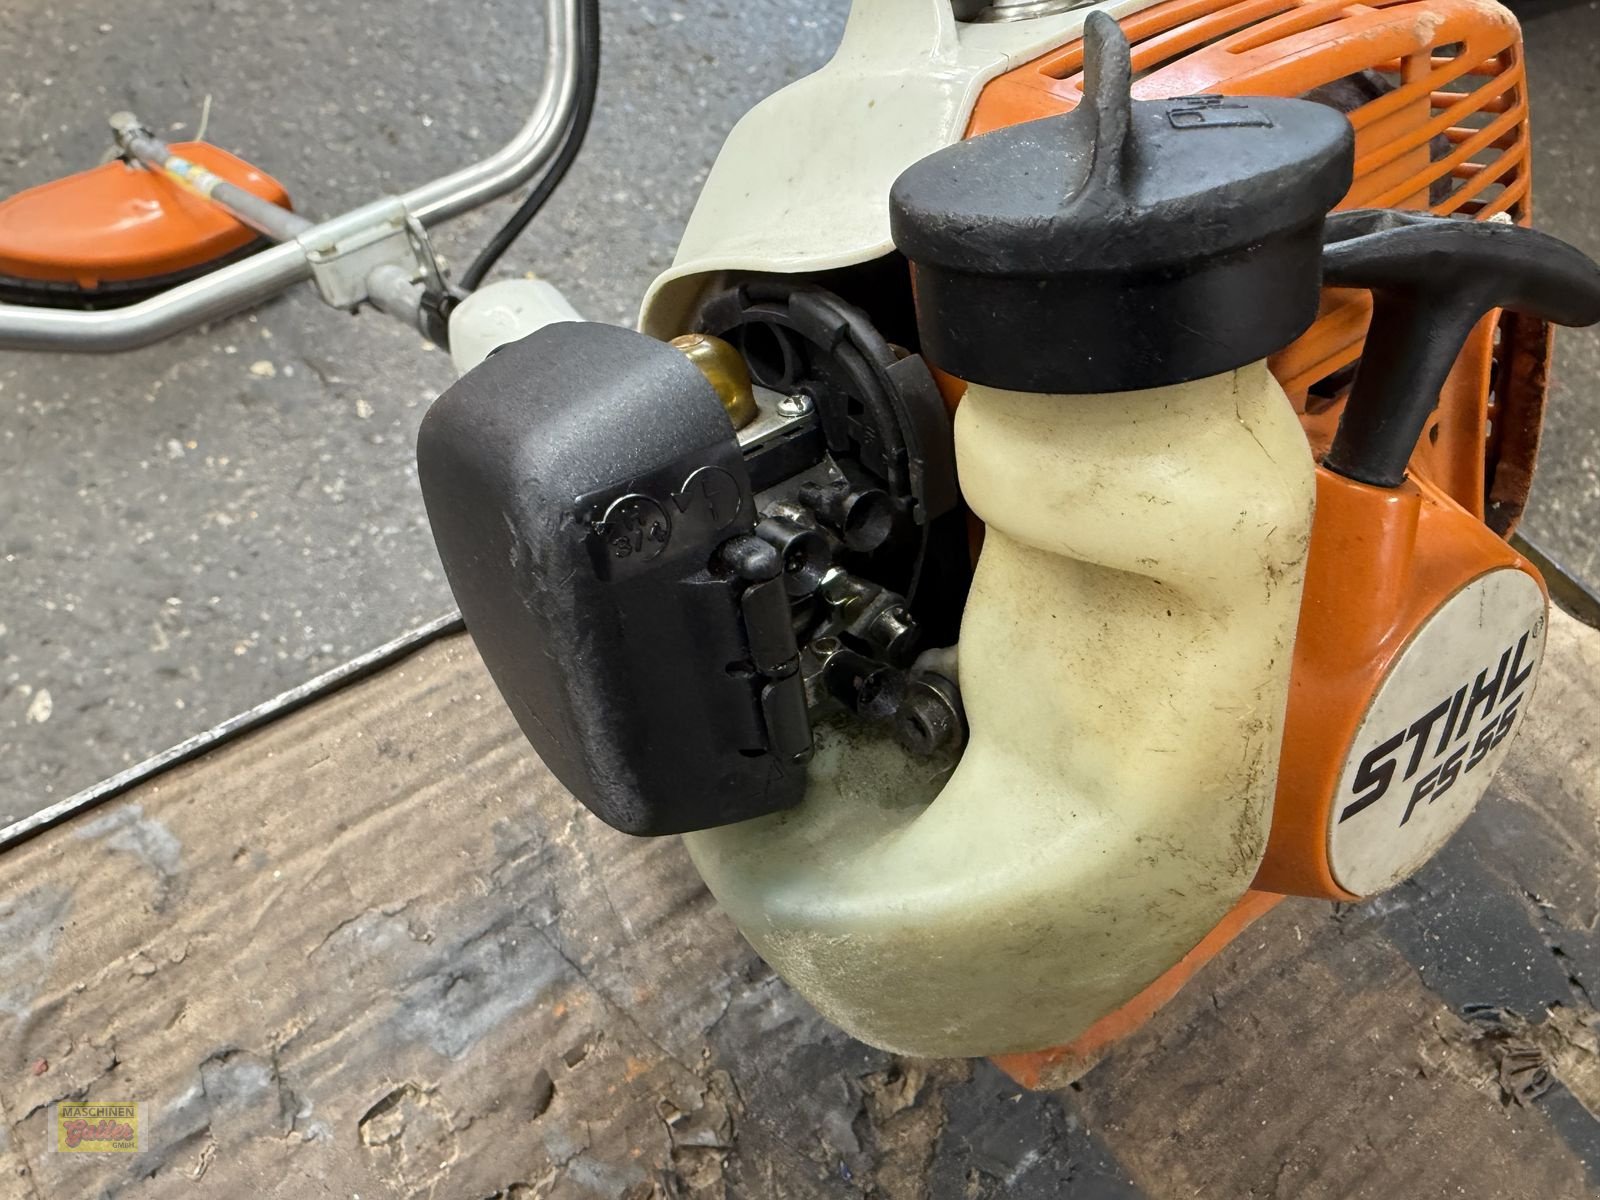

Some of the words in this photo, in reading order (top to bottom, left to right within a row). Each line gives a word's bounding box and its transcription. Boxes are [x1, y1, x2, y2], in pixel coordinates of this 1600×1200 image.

[1339, 630, 1534, 824] STIHL
[1400, 742, 1469, 827] FS
[1465, 692, 1523, 773] 55
